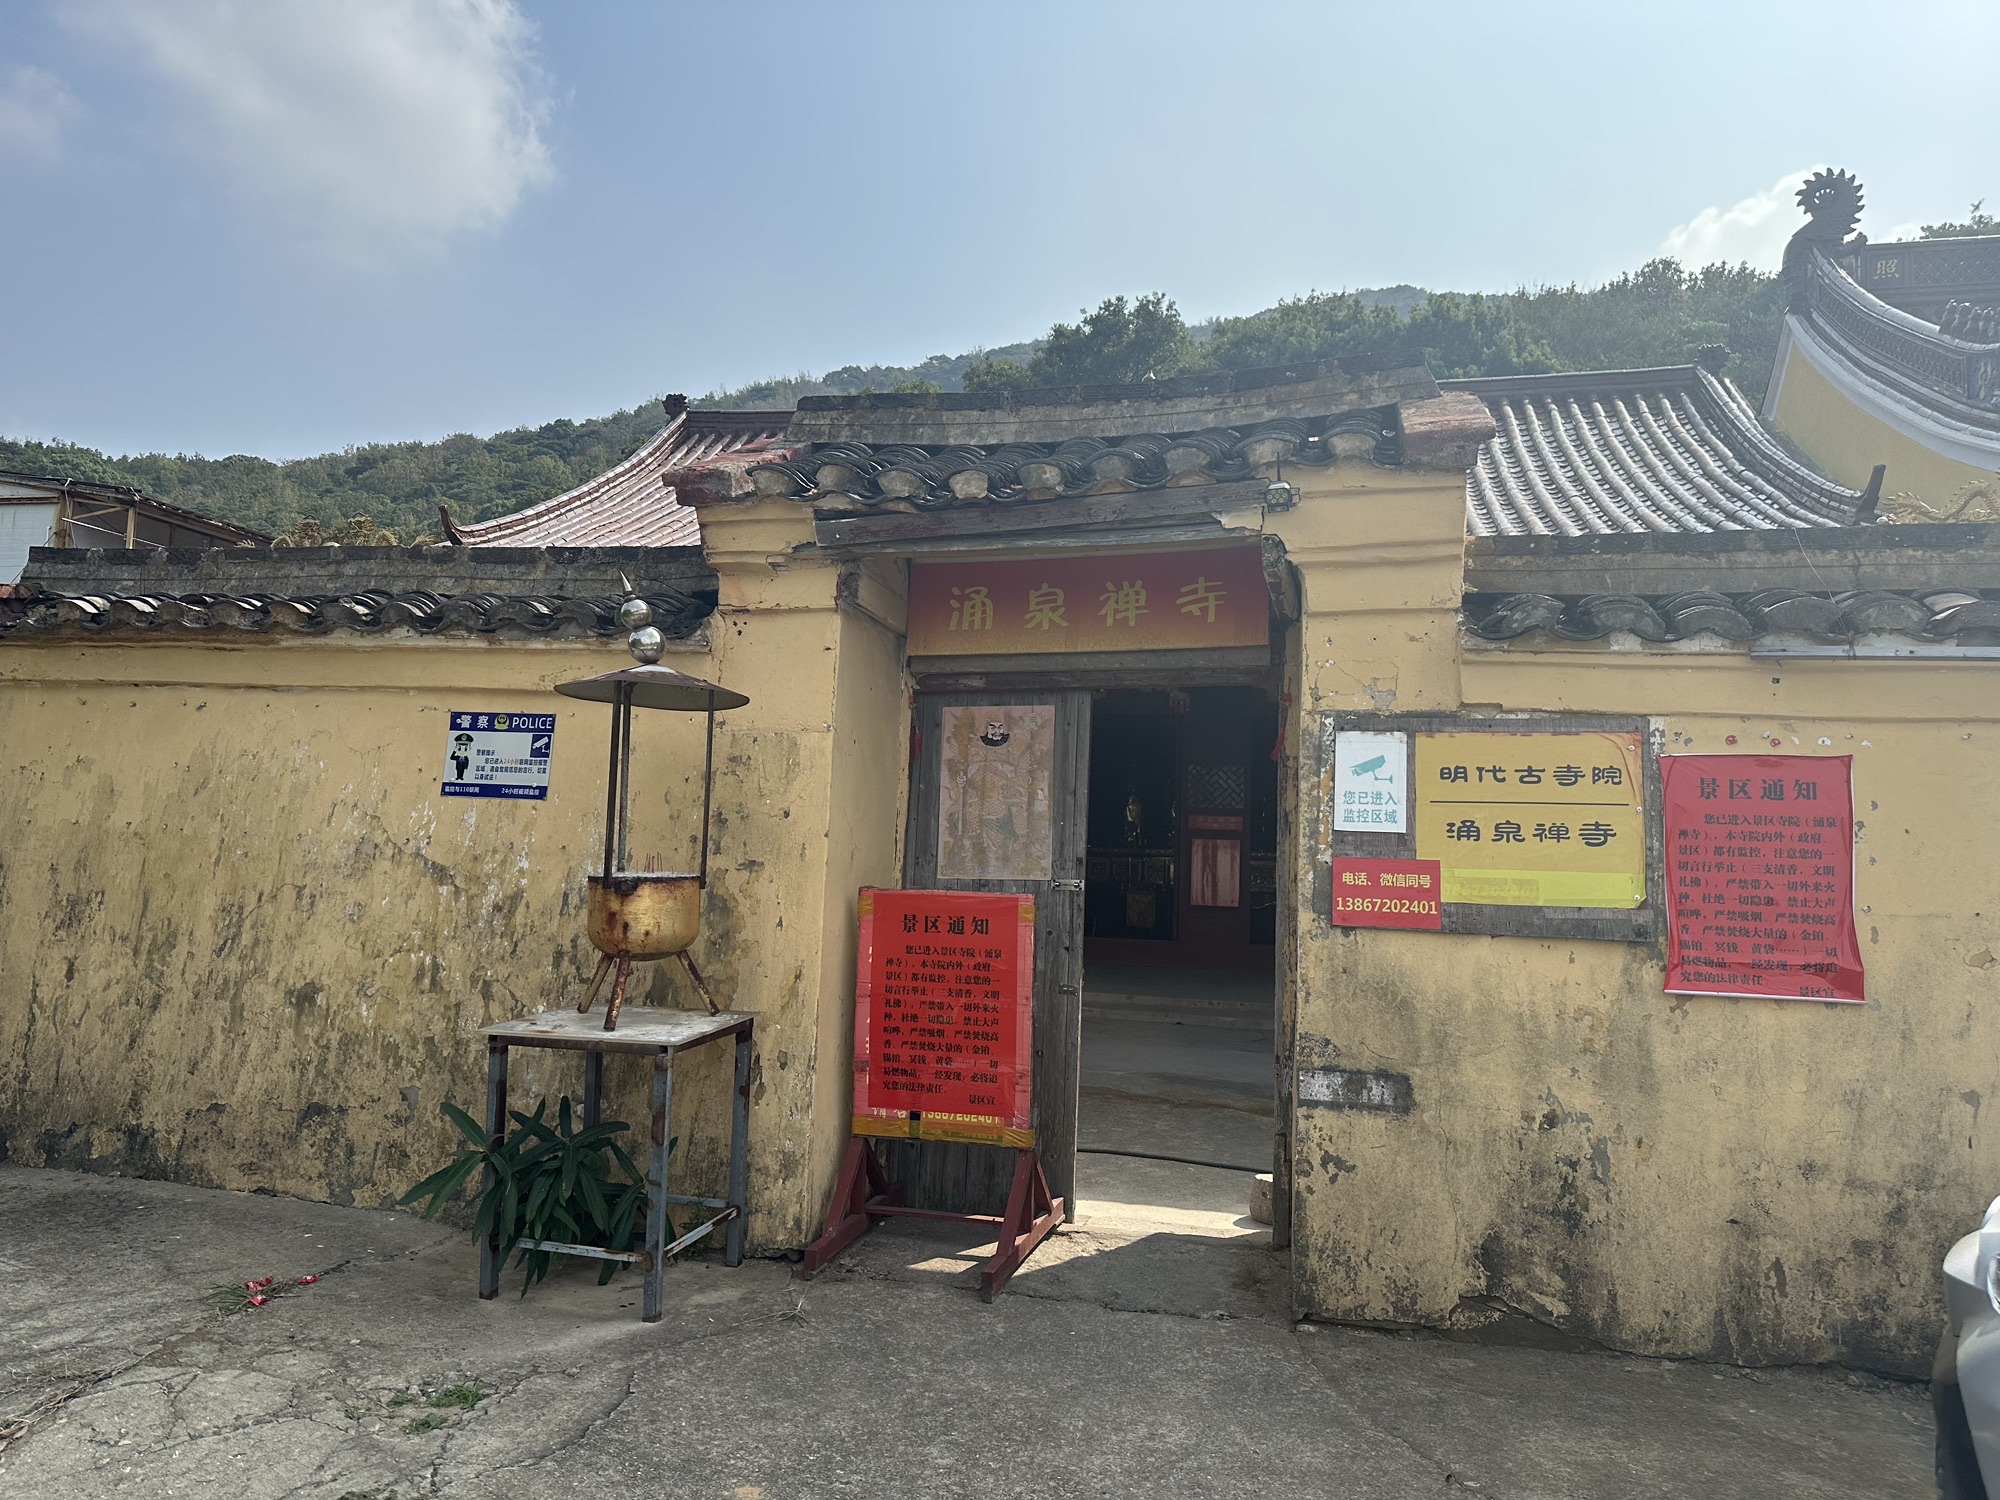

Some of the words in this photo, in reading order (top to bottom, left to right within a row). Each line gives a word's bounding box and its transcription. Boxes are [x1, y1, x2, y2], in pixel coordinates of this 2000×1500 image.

[1873, 259, 1900, 280] 照
[948, 576, 1228, 631] 涌泉禅寺
[460, 714, 489, 729] 警察
[511, 716, 553, 729] POLICE
[1439, 764, 1623, 787] 明代古寺院
[1696, 777, 1818, 801] 景区通知
[1343, 790, 1398, 806] 您已进入
[1342, 808, 1398, 825] 监控区域
[1704, 814, 1837, 828] 您已进入景区寺院（涌泉
[1446, 819, 1617, 848] 涌泉禅寺
[1342, 872, 1432, 888] 电话、微信同号
[1336, 897, 1438, 915] 13867202401
[901, 913, 989, 936] 景区通知
[905, 945, 1003, 959] 您已进入景区寺院（涌泉
[968, 1094, 996, 1105] 景区宣
